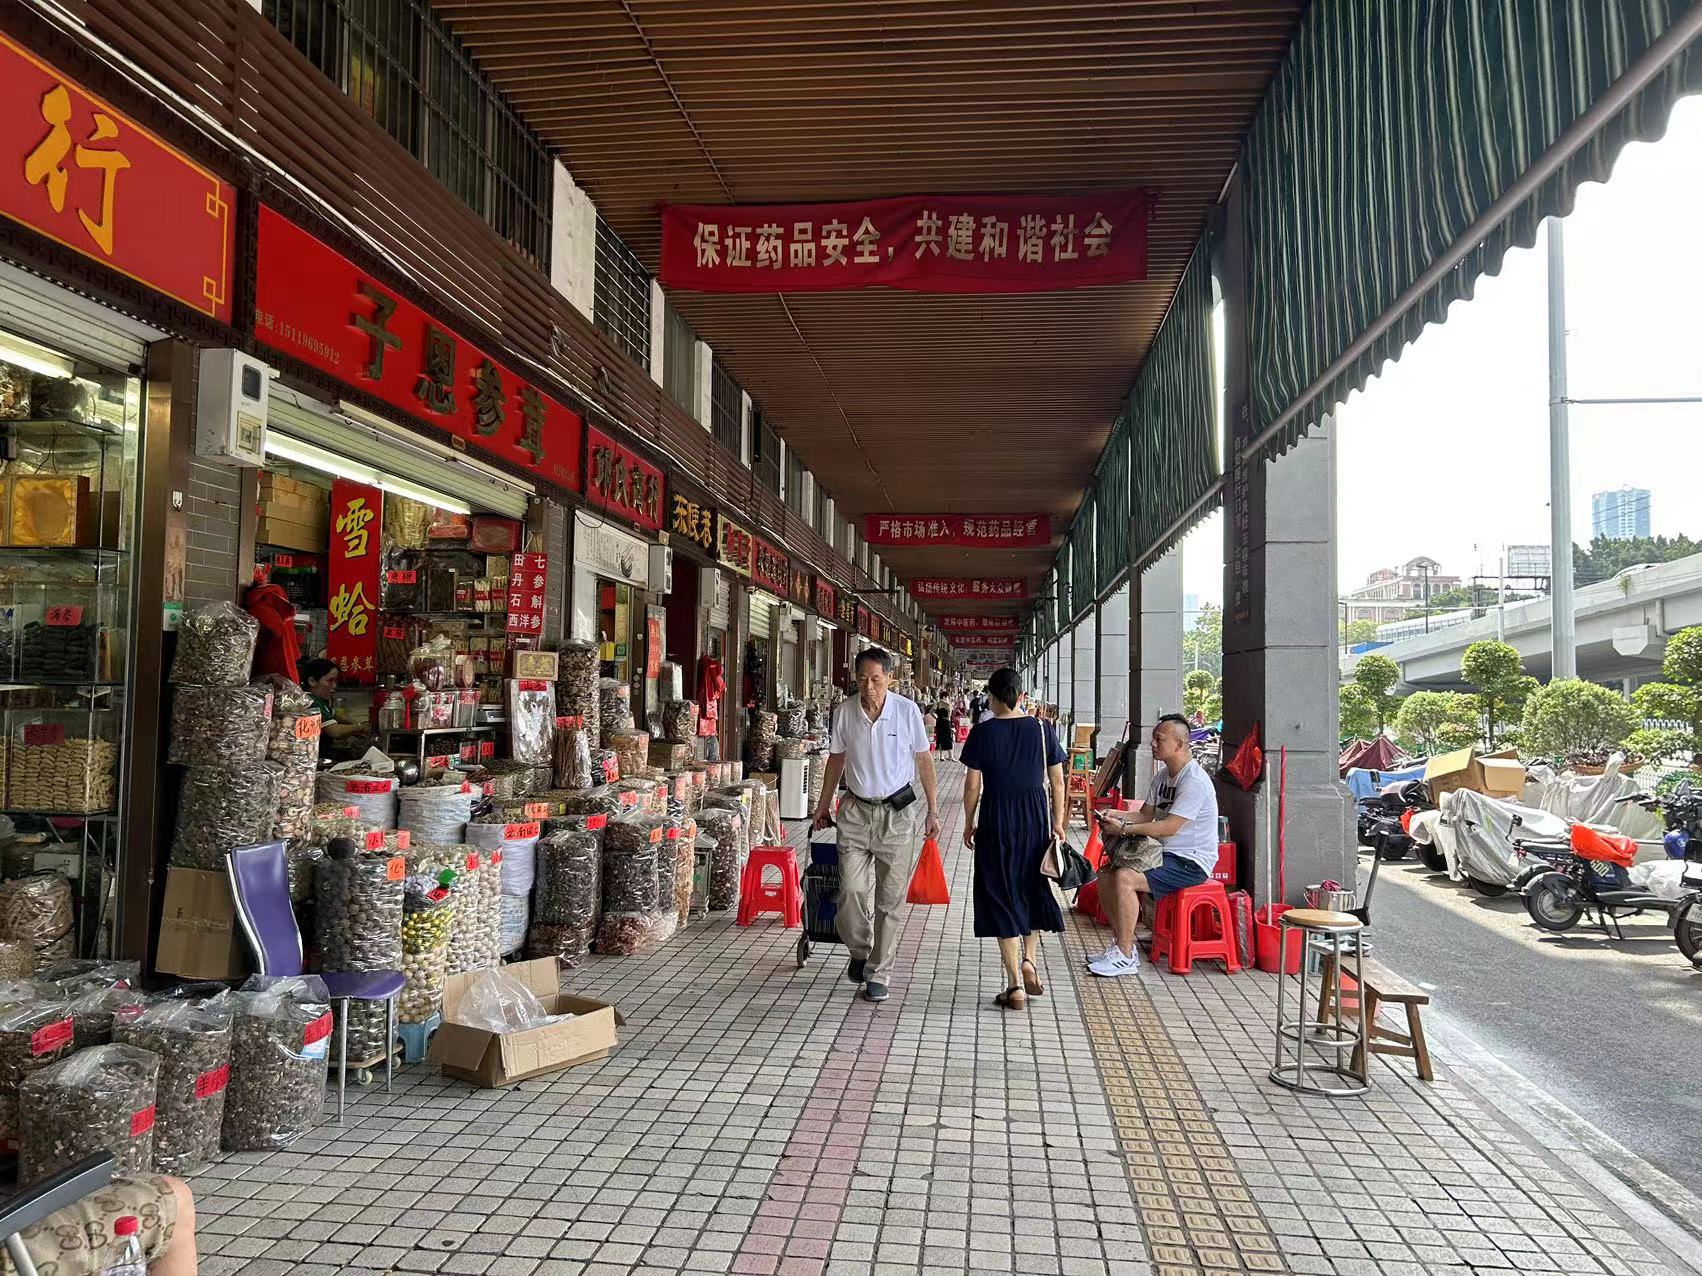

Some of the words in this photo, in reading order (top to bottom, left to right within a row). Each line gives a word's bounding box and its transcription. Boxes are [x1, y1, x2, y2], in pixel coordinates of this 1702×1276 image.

[25, 84, 131, 256] 行
[350, 278, 547, 467] 子恩参茸
[328, 497, 376, 636] 雪蛤
[508, 613, 541, 630] 西洋参
